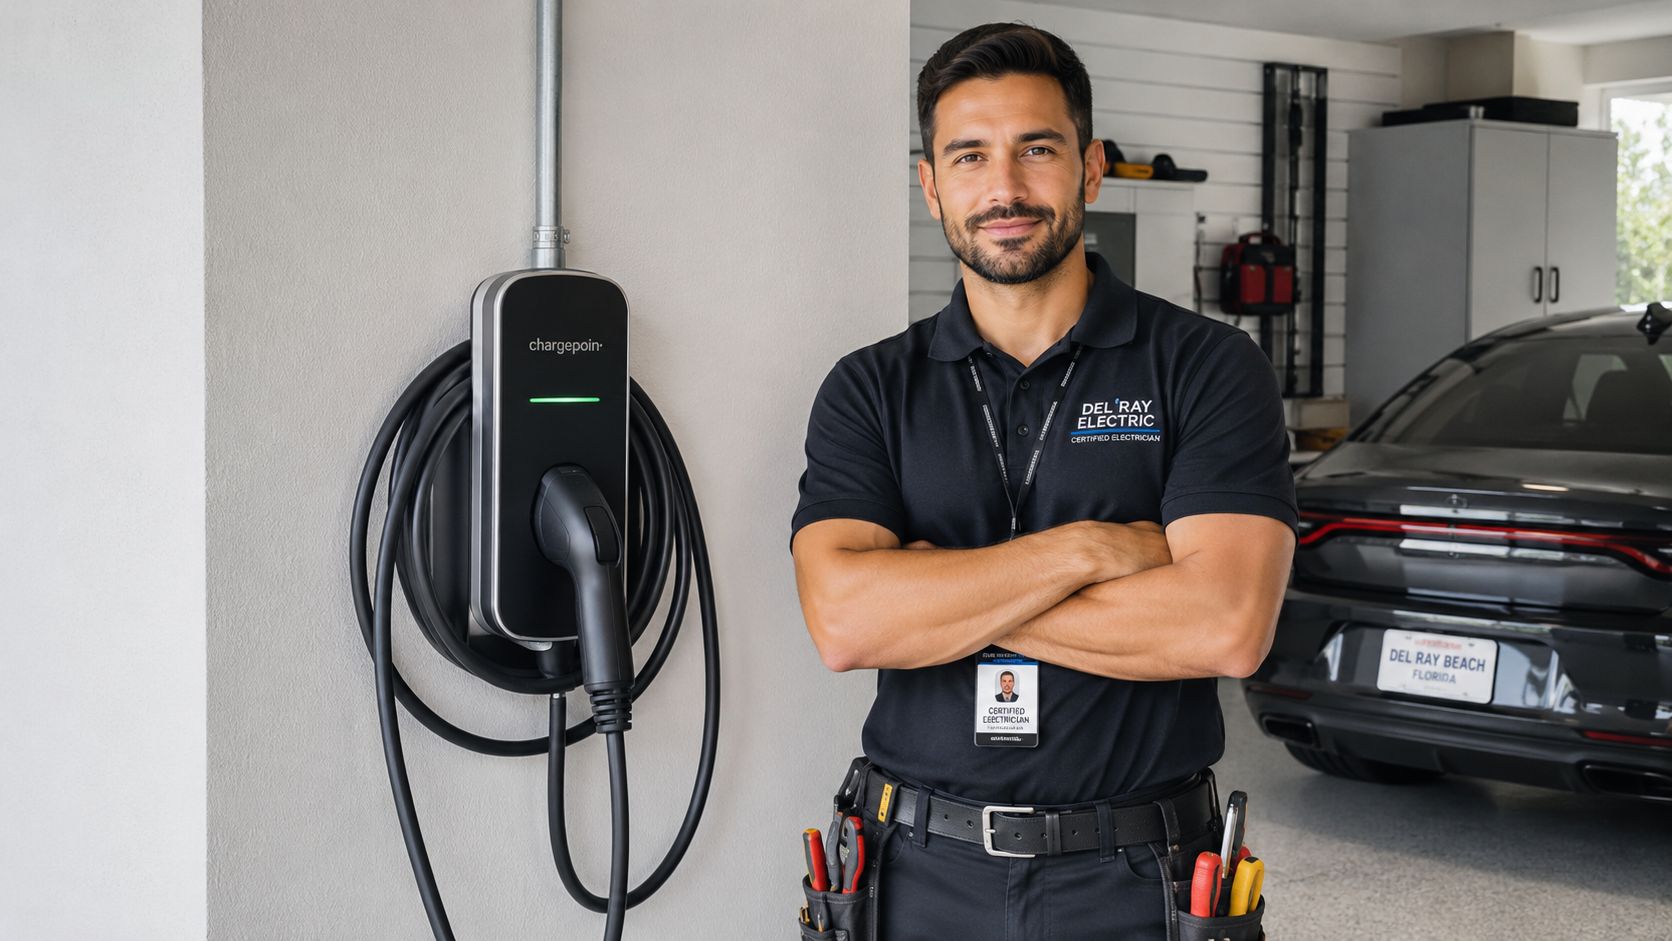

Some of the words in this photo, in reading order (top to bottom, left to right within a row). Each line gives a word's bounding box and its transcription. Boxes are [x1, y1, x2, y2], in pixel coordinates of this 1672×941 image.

[1082, 401, 1113, 416] DEL
[1077, 414, 1155, 430] ELECTRIC
[1389, 648, 1412, 664] DEL
[1415, 651, 1441, 667] RAY
[1443, 655, 1487, 673] BEACH
[1411, 668, 1457, 685] FLORIDA
